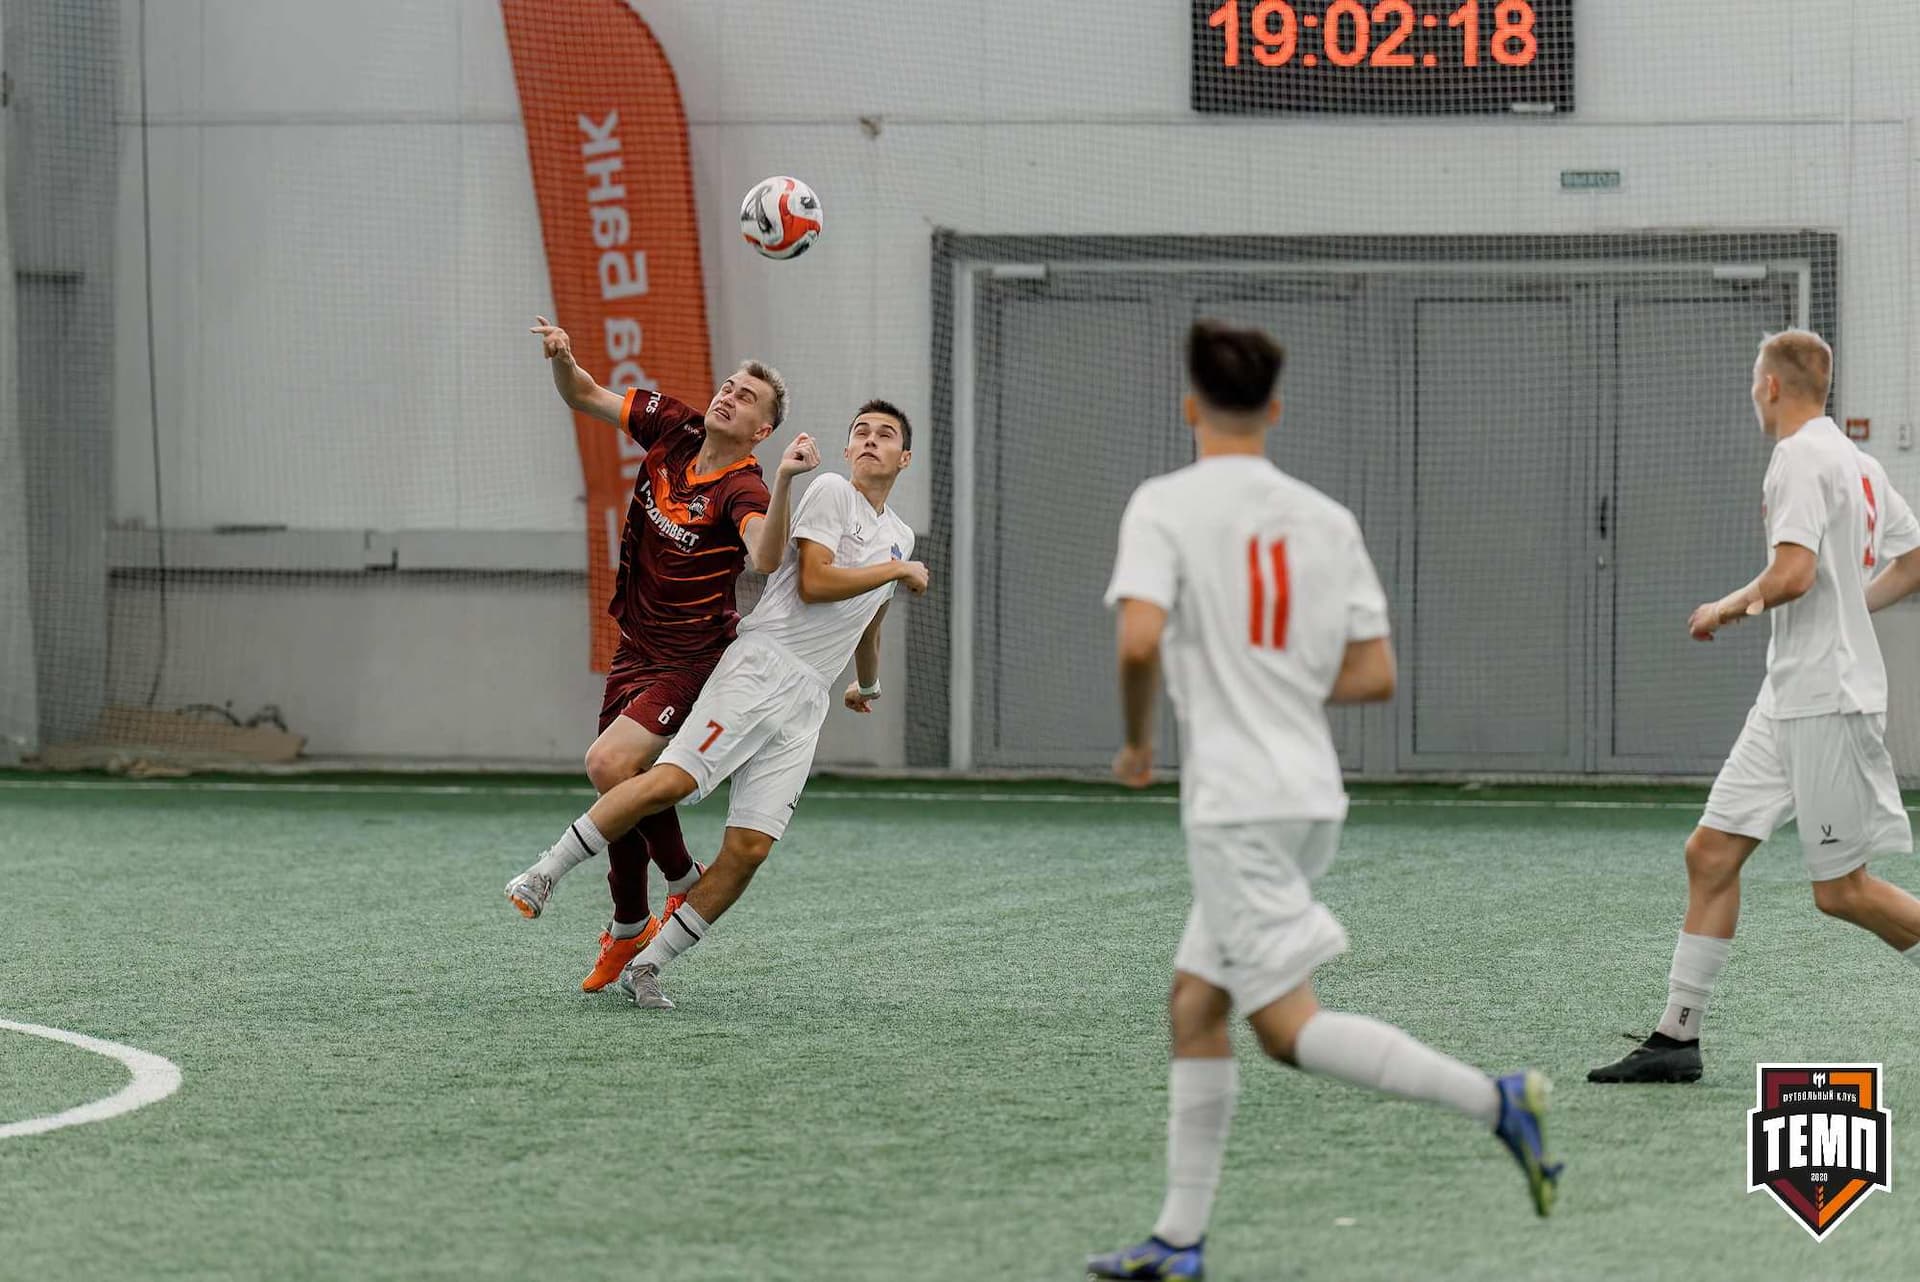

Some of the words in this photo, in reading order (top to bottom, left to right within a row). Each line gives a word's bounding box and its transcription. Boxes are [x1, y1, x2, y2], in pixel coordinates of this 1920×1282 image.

[1208, 0, 1538, 67] 19:02:18
[1247, 535, 1291, 651] 11
[657, 705, 675, 725] 6
[698, 719, 725, 753] 7
